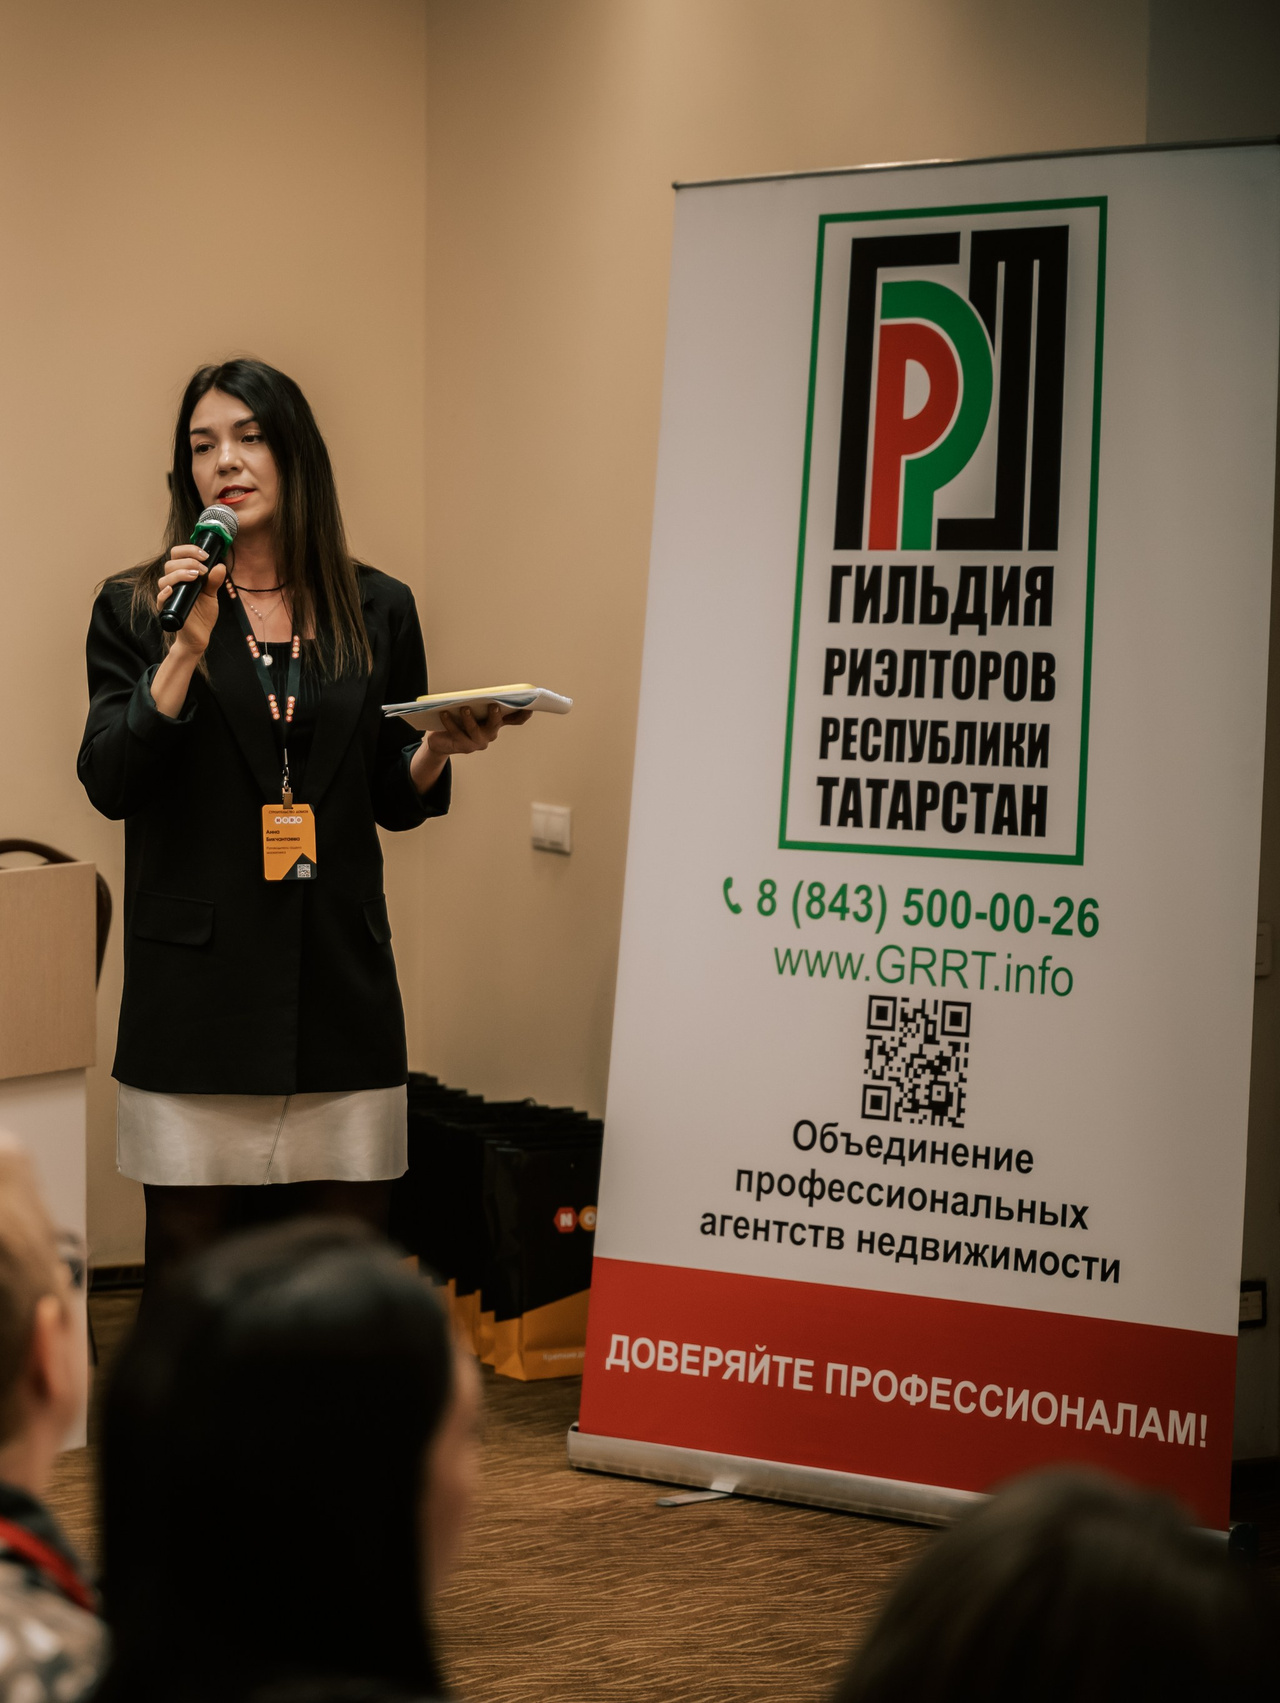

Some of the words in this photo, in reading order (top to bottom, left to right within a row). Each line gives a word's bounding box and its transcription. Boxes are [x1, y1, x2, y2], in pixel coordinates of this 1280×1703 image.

[827, 564, 1056, 637] ГИЛЬДИЯ
[822, 647, 1057, 703] РИЭЛТОРОВ
[818, 716, 1051, 769] РЕСПУБЛИКИ
[815, 776, 1050, 838] ТАТАРСТАН
[756, 879, 778, 917] 8
[791, 880, 888, 934] (843)
[902, 887, 1100, 939] 500-00-26
[774, 944, 1075, 997] www.GRRT.info
[792, 1119, 1034, 1175] Объединение
[735, 1168, 1090, 1231] профессиональных
[700, 1212, 846, 1251] агентств
[857, 1230, 1122, 1285] недвижимости
[605, 1333, 815, 1392] ДОВЕРЯЙТЕ
[825, 1362, 1208, 1448] ПРОФЕССИОНАЛАМ!
